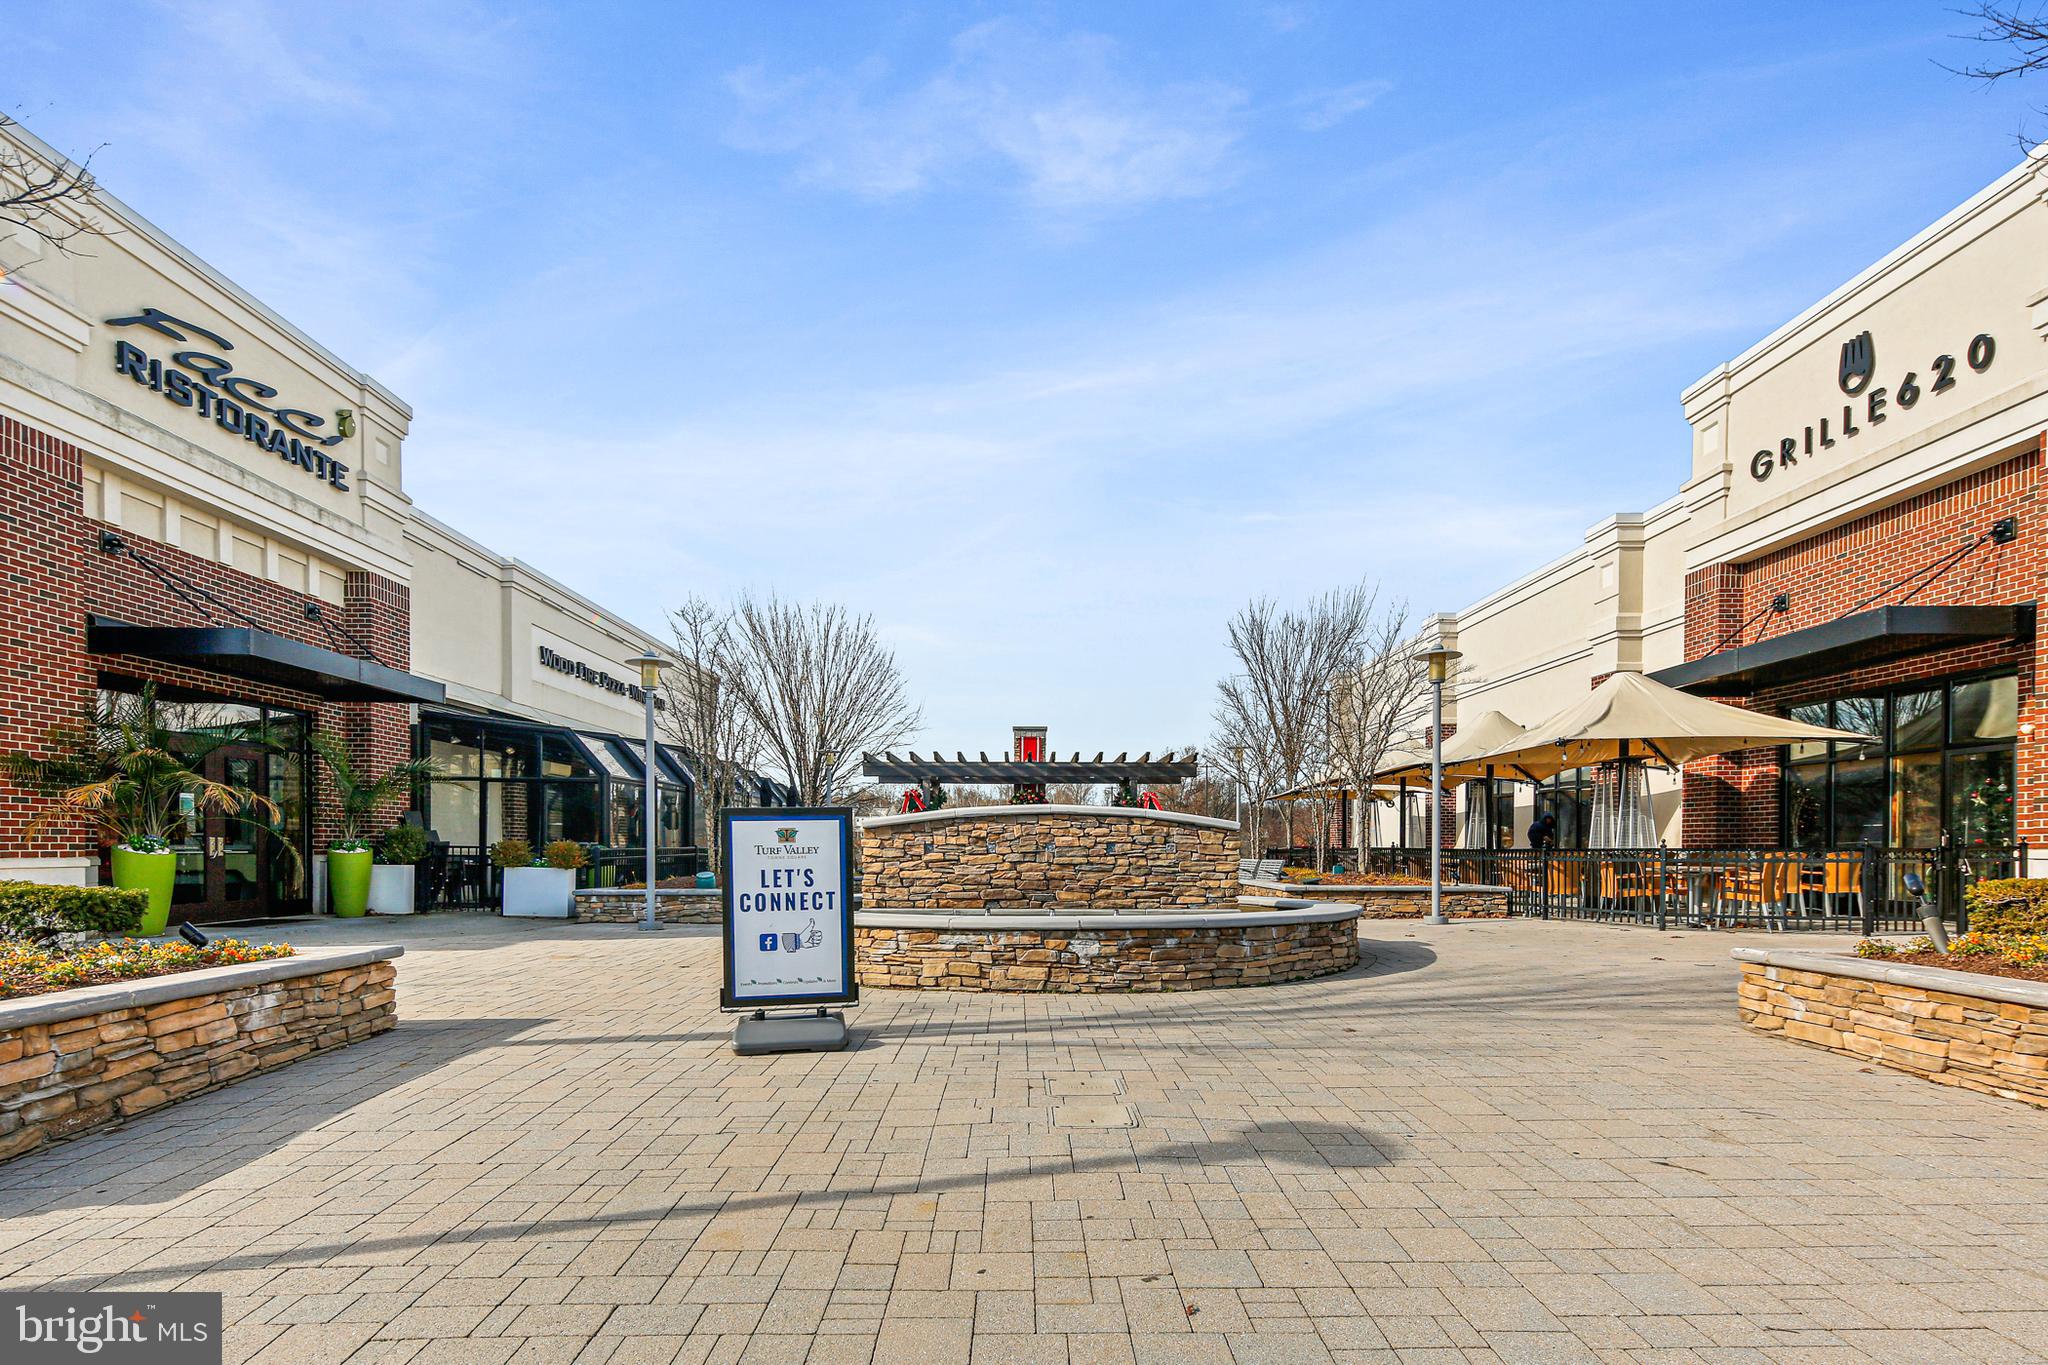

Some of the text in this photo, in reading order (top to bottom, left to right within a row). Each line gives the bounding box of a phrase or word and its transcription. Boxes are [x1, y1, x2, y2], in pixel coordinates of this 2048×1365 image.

[116, 340, 350, 492] RISTORANTE
[754, 845, 819, 855] TURF VALLEY
[760, 868, 814, 888] LET'S
[739, 891, 836, 912] CONNECT
